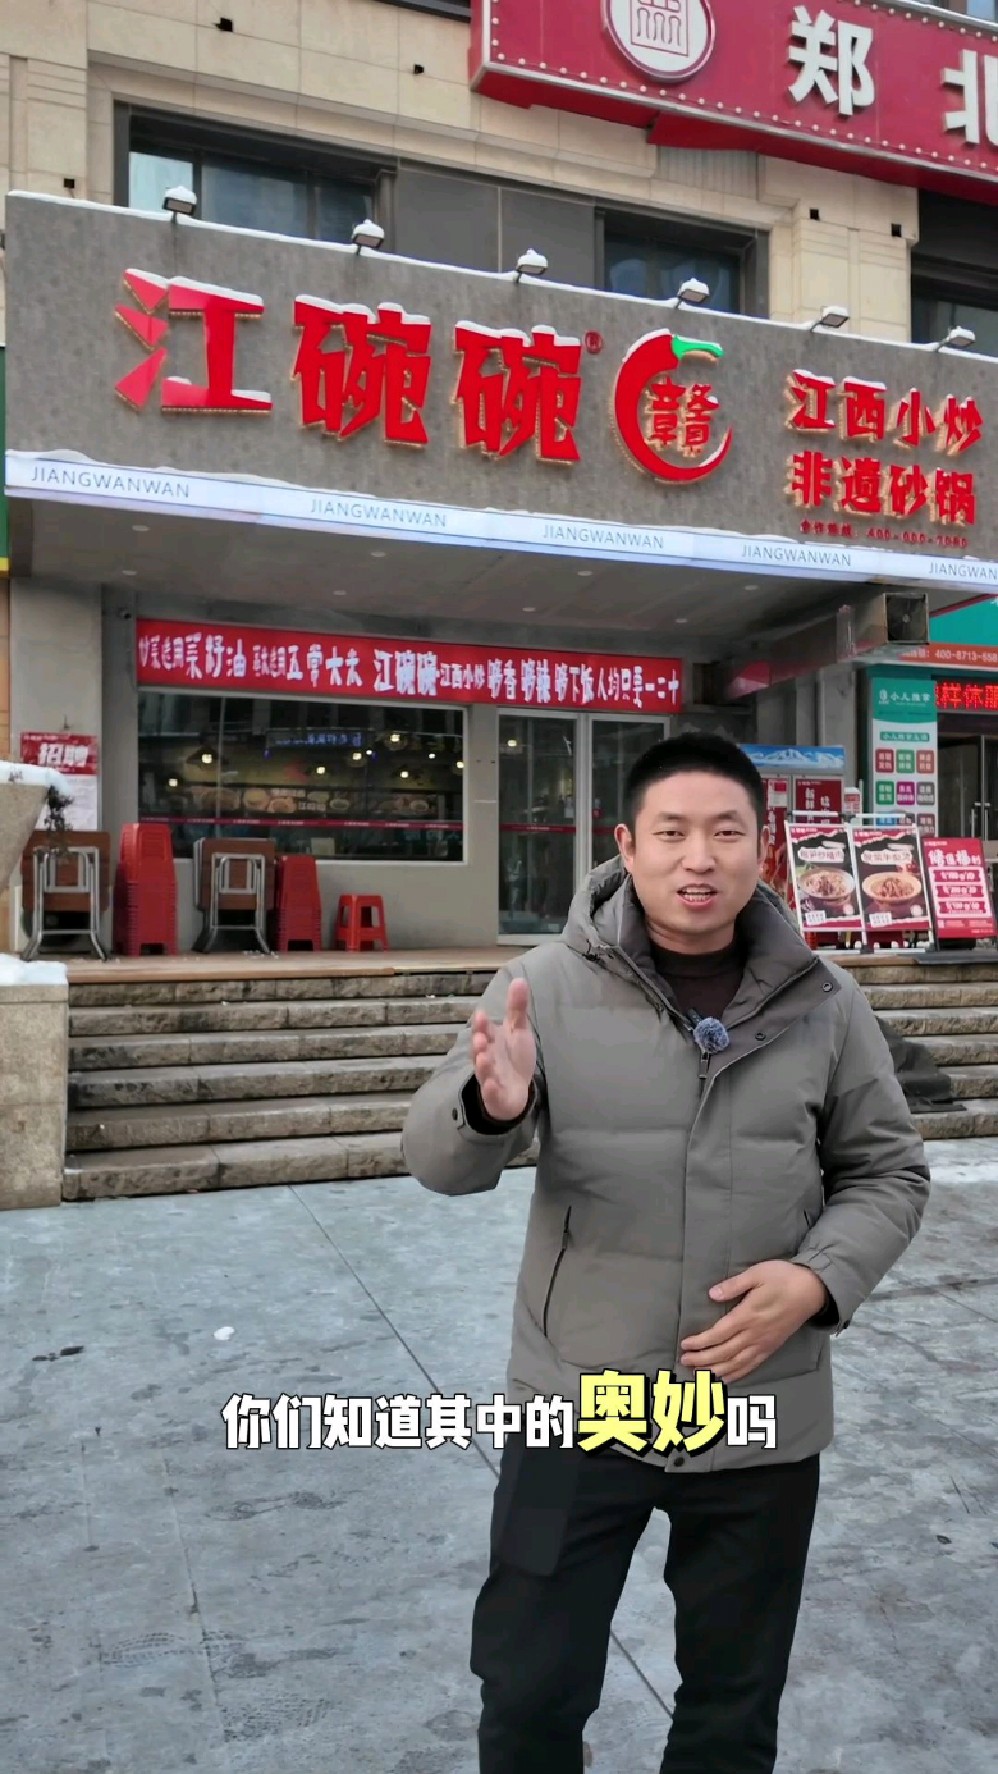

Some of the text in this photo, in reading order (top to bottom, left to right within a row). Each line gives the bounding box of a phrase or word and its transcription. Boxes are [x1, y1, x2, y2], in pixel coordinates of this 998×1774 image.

[114, 268, 582, 465] 江碗碗
[785, 369, 984, 457] 江西小炒
[31, 466, 190, 499] JIANGWANWAN
[784, 450, 976, 527] 非遗砂锅
[311, 498, 447, 527] JIANGWANWAN
[543, 524, 664, 550] JIANGWANWAN
[742, 544, 852, 567] JIANGWANWAN
